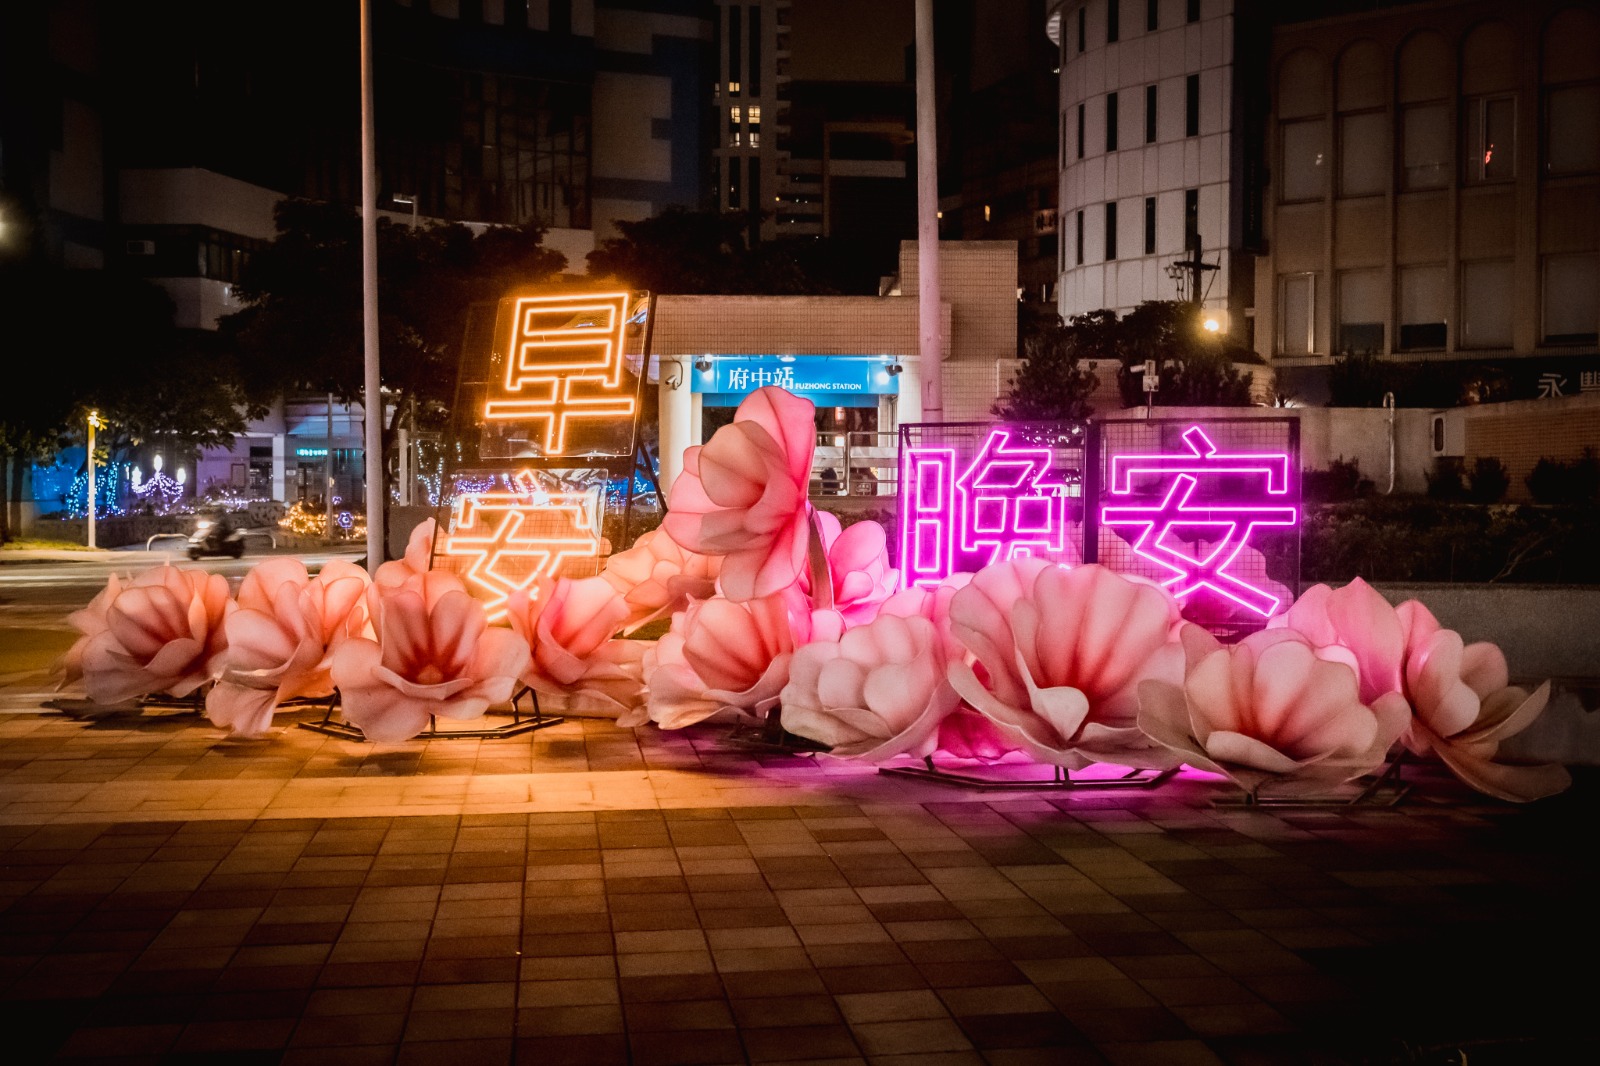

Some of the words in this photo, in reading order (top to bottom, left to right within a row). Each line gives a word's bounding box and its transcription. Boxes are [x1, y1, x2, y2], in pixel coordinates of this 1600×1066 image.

[728, 367, 794, 391] 府中站
[795, 382, 831, 390] FUZHONG
[832, 383, 862, 391] STATION
